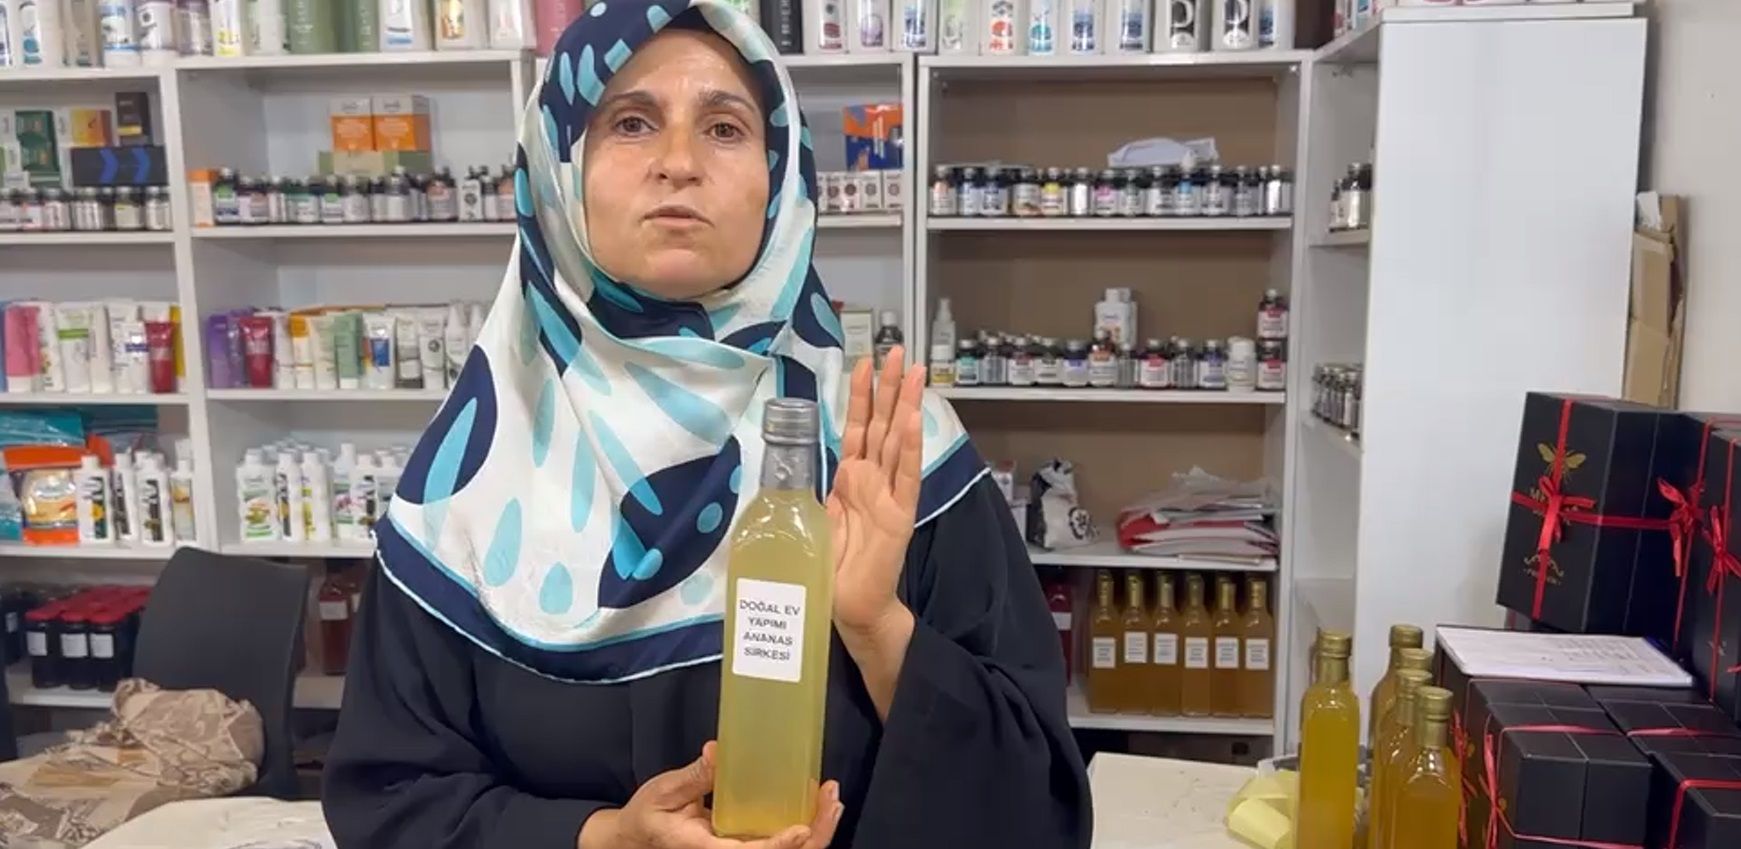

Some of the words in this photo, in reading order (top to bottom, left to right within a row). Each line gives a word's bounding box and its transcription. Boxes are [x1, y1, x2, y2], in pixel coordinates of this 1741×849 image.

[740, 599, 780, 615] DOĞAL
[784, 606, 801, 616] EV
[748, 617, 787, 630] YAPIMI
[743, 631, 793, 646] ANANAS
